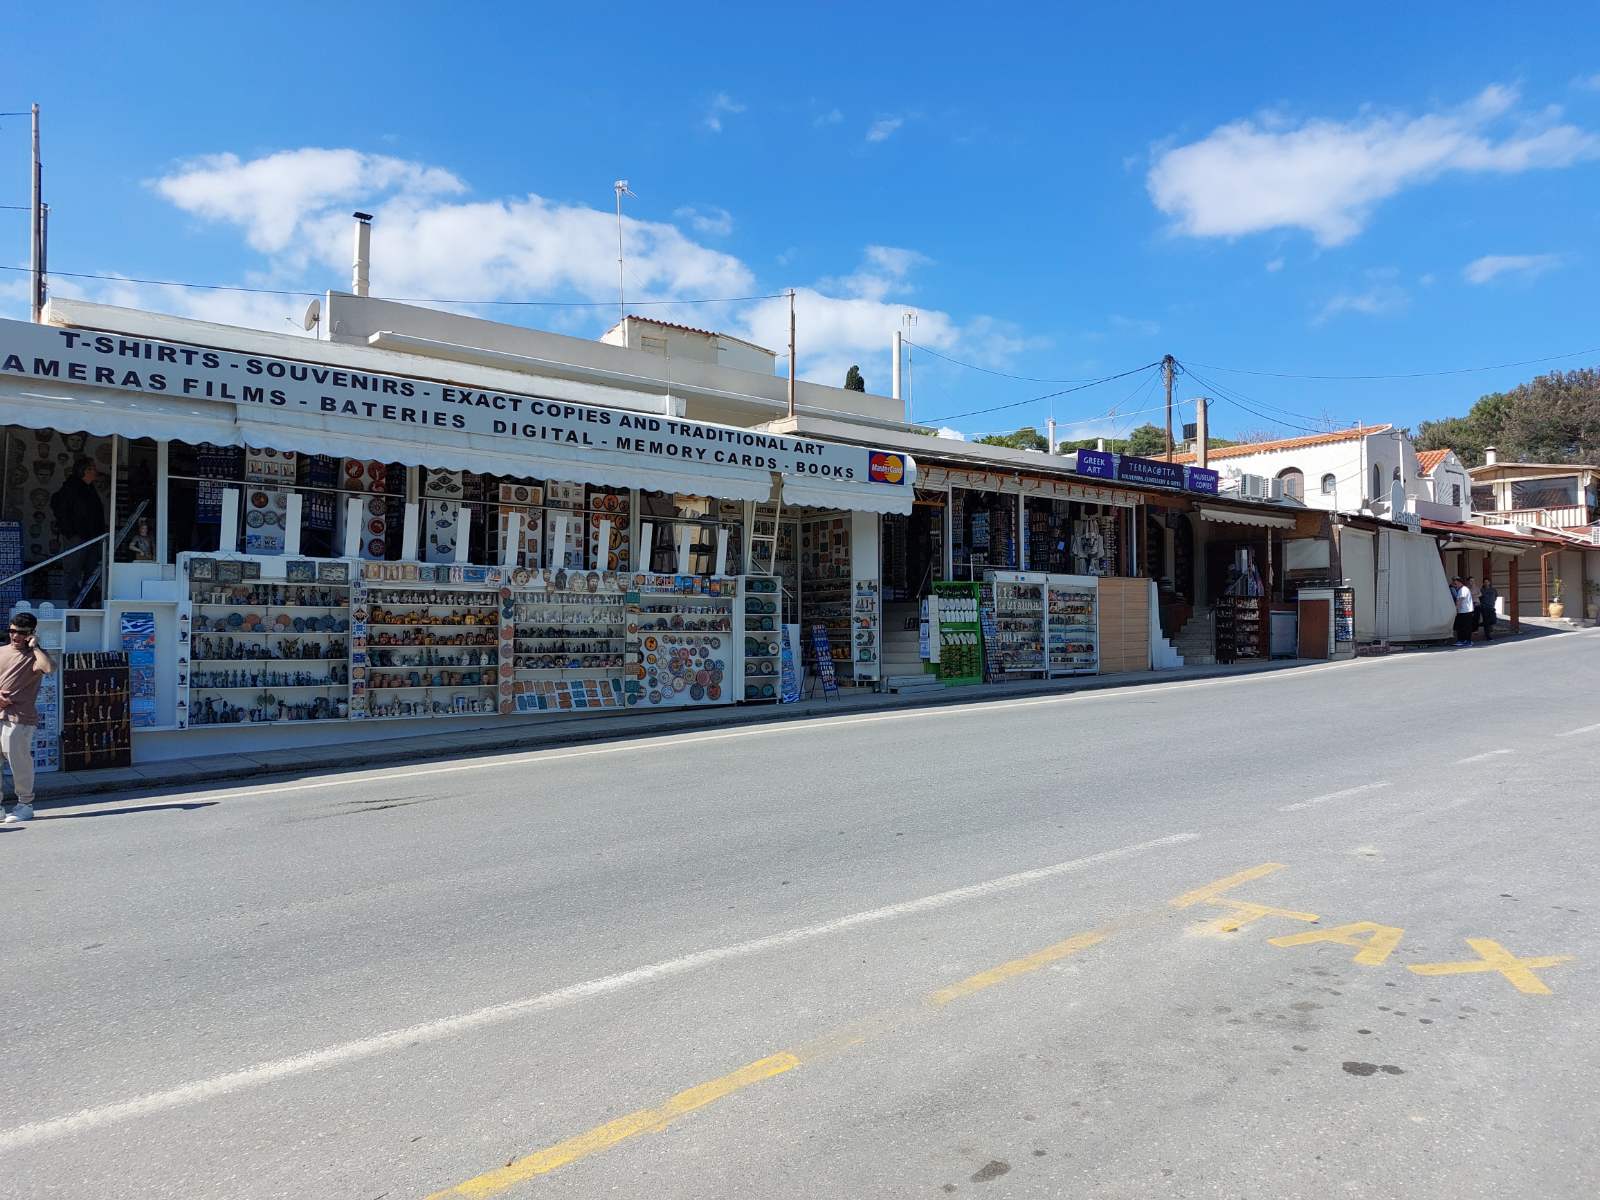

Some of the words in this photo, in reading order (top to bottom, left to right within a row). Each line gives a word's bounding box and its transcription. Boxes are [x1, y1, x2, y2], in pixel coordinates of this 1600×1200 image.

[58, 330, 221, 370] T-SHIRTS
[246, 358, 416, 397] SOUVENIRS
[443, 387, 523, 413] EXACT
[530, 401, 612, 426] COPIES
[618, 414, 661, 434] AND
[666, 421, 789, 452] TRADITIONAL
[793, 441, 826, 457] ART
[182, 377, 287, 406] FILMS
[320, 396, 466, 430] BATERIES
[493, 419, 594, 447] DIGITAL
[616, 436, 708, 461] MEMORY
[714, 450, 778, 471] CARDS
[796, 461, 855, 480] BOOKS
[1083, 456, 1106, 466] GREEK
[1086, 466, 1102, 475] ART
[1193, 473, 1216, 483] MUSEUM
